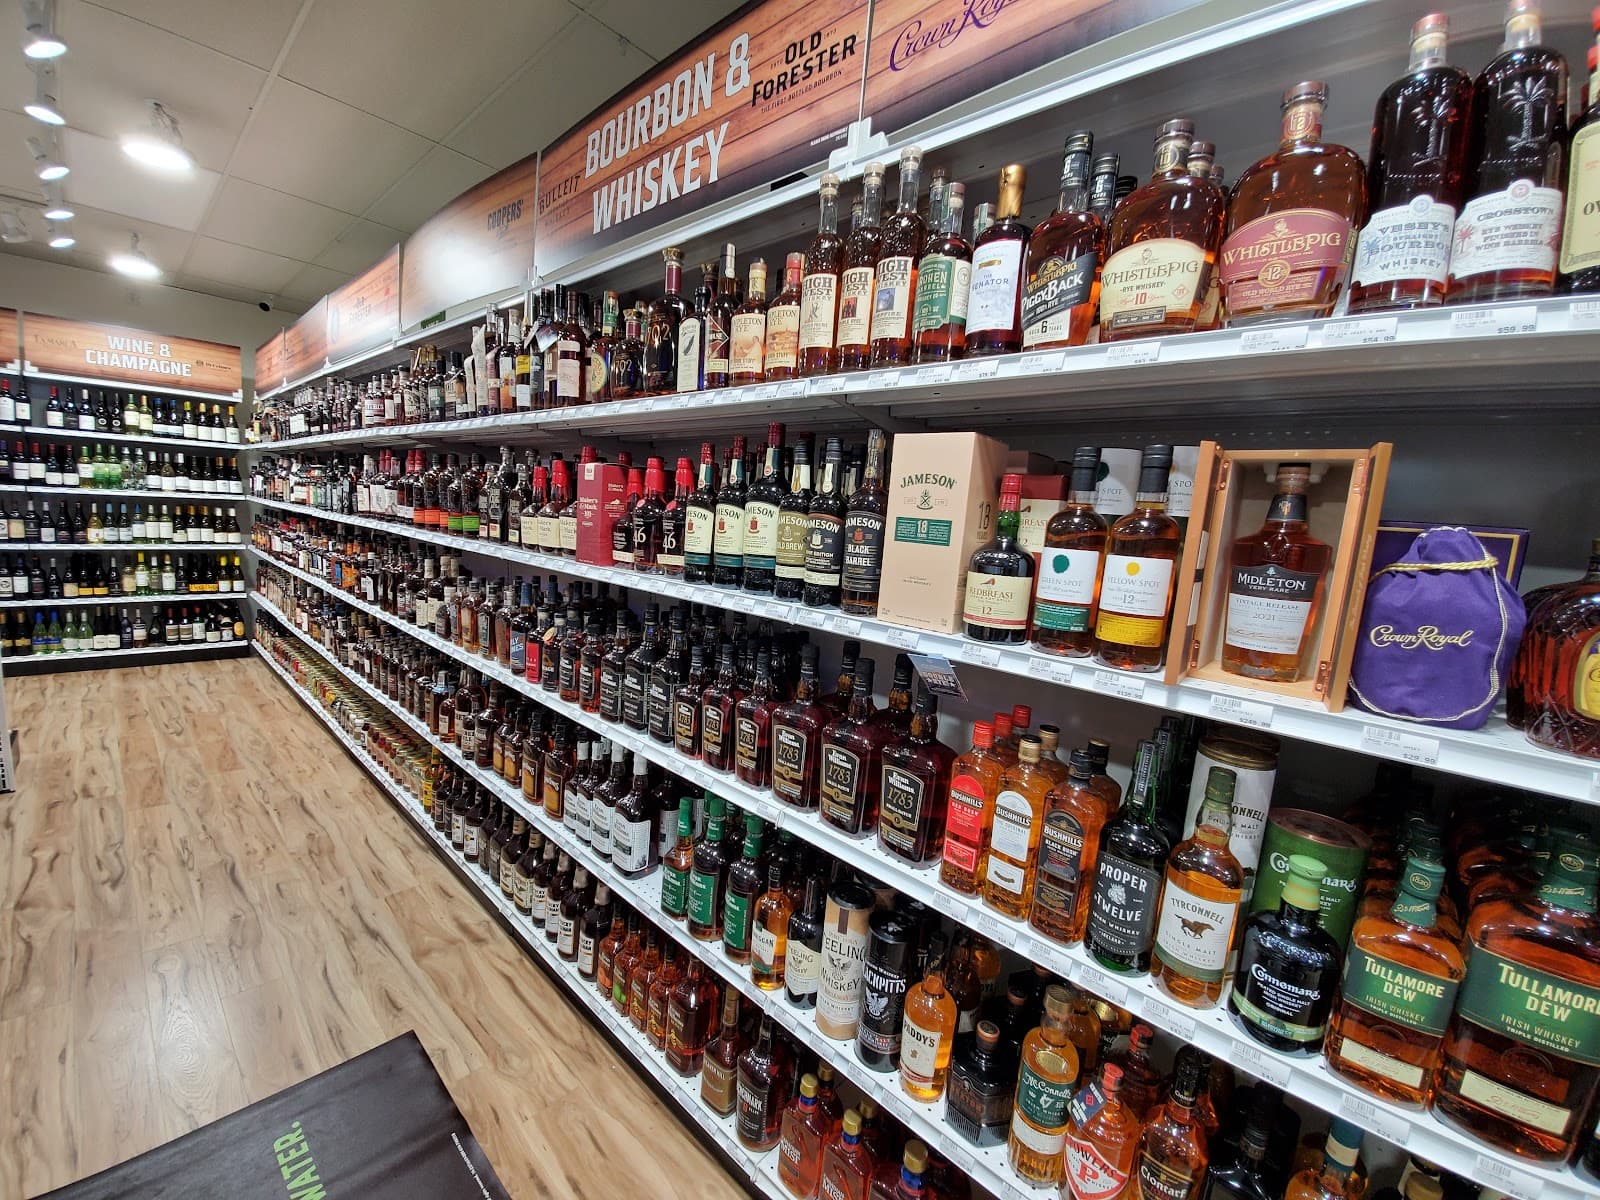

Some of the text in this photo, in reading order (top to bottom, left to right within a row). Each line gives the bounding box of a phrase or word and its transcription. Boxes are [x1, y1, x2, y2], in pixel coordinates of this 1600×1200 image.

[785, 30, 822, 65] OLD
[889, 20, 957, 71] Crown
[752, 34, 857, 107] FORESTER
[585, 32, 753, 179] BOURBON &
[592, 121, 730, 235] WHISKEY
[539, 175, 581, 216] BULLEIT
[1477, 206, 1554, 222] CROSSTOWN
[1223, 233, 1341, 266] WHISTLEPIG
[1267, 263, 1281, 280] 12
[1379, 258, 1441, 270] WHISKEY
[804, 277, 833, 290] HIGH
[1101, 260, 1198, 289] WHISTLEPIG
[1123, 281, 1165, 293] RYE WHISKEY
[1134, 292, 1147, 305] 10
[1041, 320, 1048, 334] 6
[107, 335, 172, 358] WINE &
[85, 350, 193, 377] CHAMPAGNE
[900, 473, 956, 490] JAMESON
[1174, 480, 1192, 488] SPO
[845, 517, 882, 531] JAMESON
[979, 501, 990, 530] 18
[917, 520, 927, 532] 18
[633, 526, 646, 548] 46
[662, 534, 676, 555] 46
[785, 542, 804, 550] BREW
[847, 544, 870, 554] BLACK
[845, 556, 872, 567] BARREL
[1064, 579, 1082, 587] SPOT
[1139, 578, 1160, 588] SPOT
[1238, 572, 1306, 591] MIDLETON
[968, 586, 1014, 600] REDBREAST
[1123, 594, 1135, 604] 12
[981, 606, 993, 615] 12
[1266, 602, 1300, 610] RELEASE
[1370, 625, 1474, 650] Crown Royal
[740, 731, 755, 745] 1783
[781, 730, 795, 741] Evan
[779, 744, 800, 760] 1783
[832, 750, 847, 761] Evan
[1403, 753, 1436, 764] $29.99
[827, 763, 851, 783] 1783
[892, 771, 910, 785] Evan
[887, 787, 913, 809] 1783
[950, 789, 984, 808] BUSHMILLS
[996, 806, 1032, 827] BUSHMILLS
[1232, 804, 1266, 822] ONNELL
[1044, 826, 1084, 848] BUSHMILLS
[1045, 840, 1078, 856] BLACK BUSH
[1099, 862, 1148, 893] PROPER
[1096, 891, 1143, 922] TWELVE
[1171, 897, 1225, 925] TYRCONNELL
[789, 944, 814, 963] EELING
[823, 931, 866, 961] EELING
[1195, 944, 1217, 956] MALT
[864, 965, 906, 993] ACKPITTS
[1251, 963, 1321, 1001] Connemara
[1364, 956, 1446, 999] TULLAMORE
[1383, 981, 1417, 1003] DEW
[1366, 994, 1426, 1023] IRISH WHISKEY
[1525, 995, 1572, 1022] DEW
[1390, 1011, 1417, 1026] DISTILLED
[903, 1019, 936, 1049] PADDY'S
[1501, 1013, 1581, 1048] IRISH WHISKEY
[1506, 1025, 1570, 1053] TRIPLE DISTILLED
[1077, 1161, 1099, 1184] P
[1141, 1165, 1188, 1199] Clontarf
